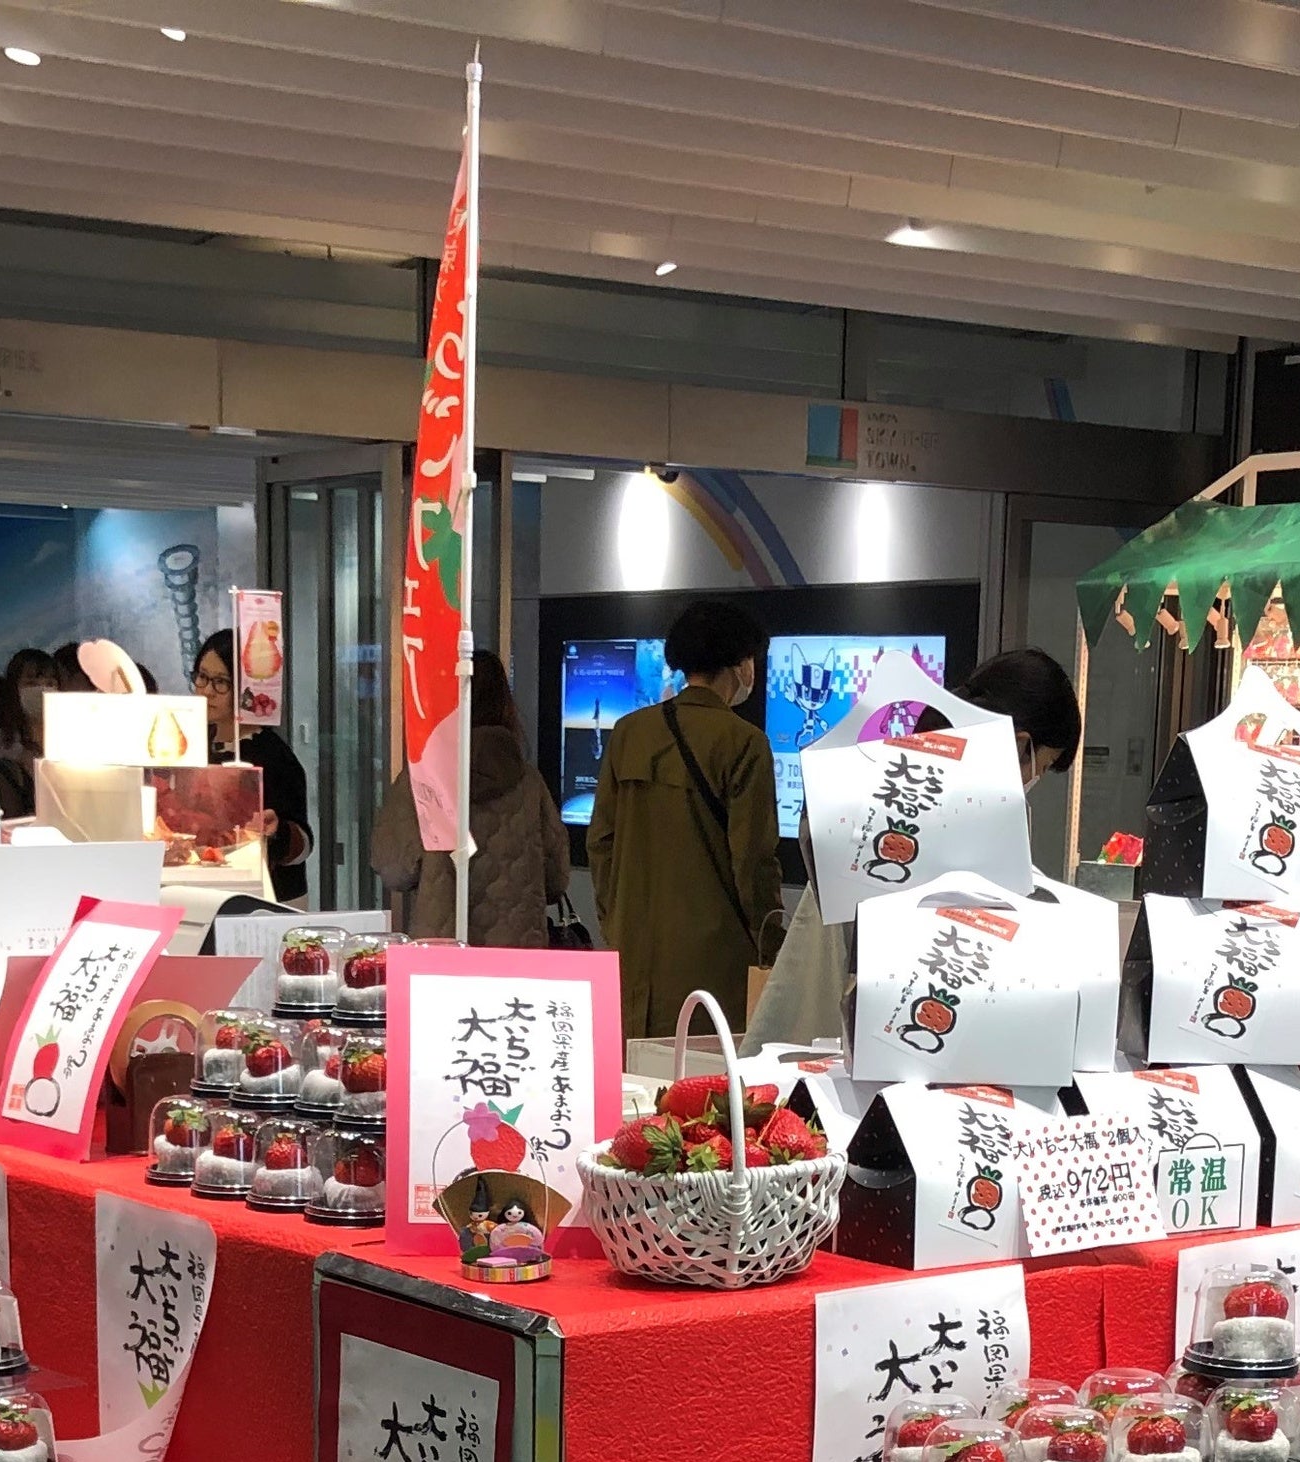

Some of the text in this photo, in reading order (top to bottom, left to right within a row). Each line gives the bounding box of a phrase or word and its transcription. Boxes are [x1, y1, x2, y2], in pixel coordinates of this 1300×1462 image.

[1066, 1162, 1133, 1198] 972円
[1168, 1156, 1227, 1196] 常温
[123, 1250, 170, 1384] 大福
